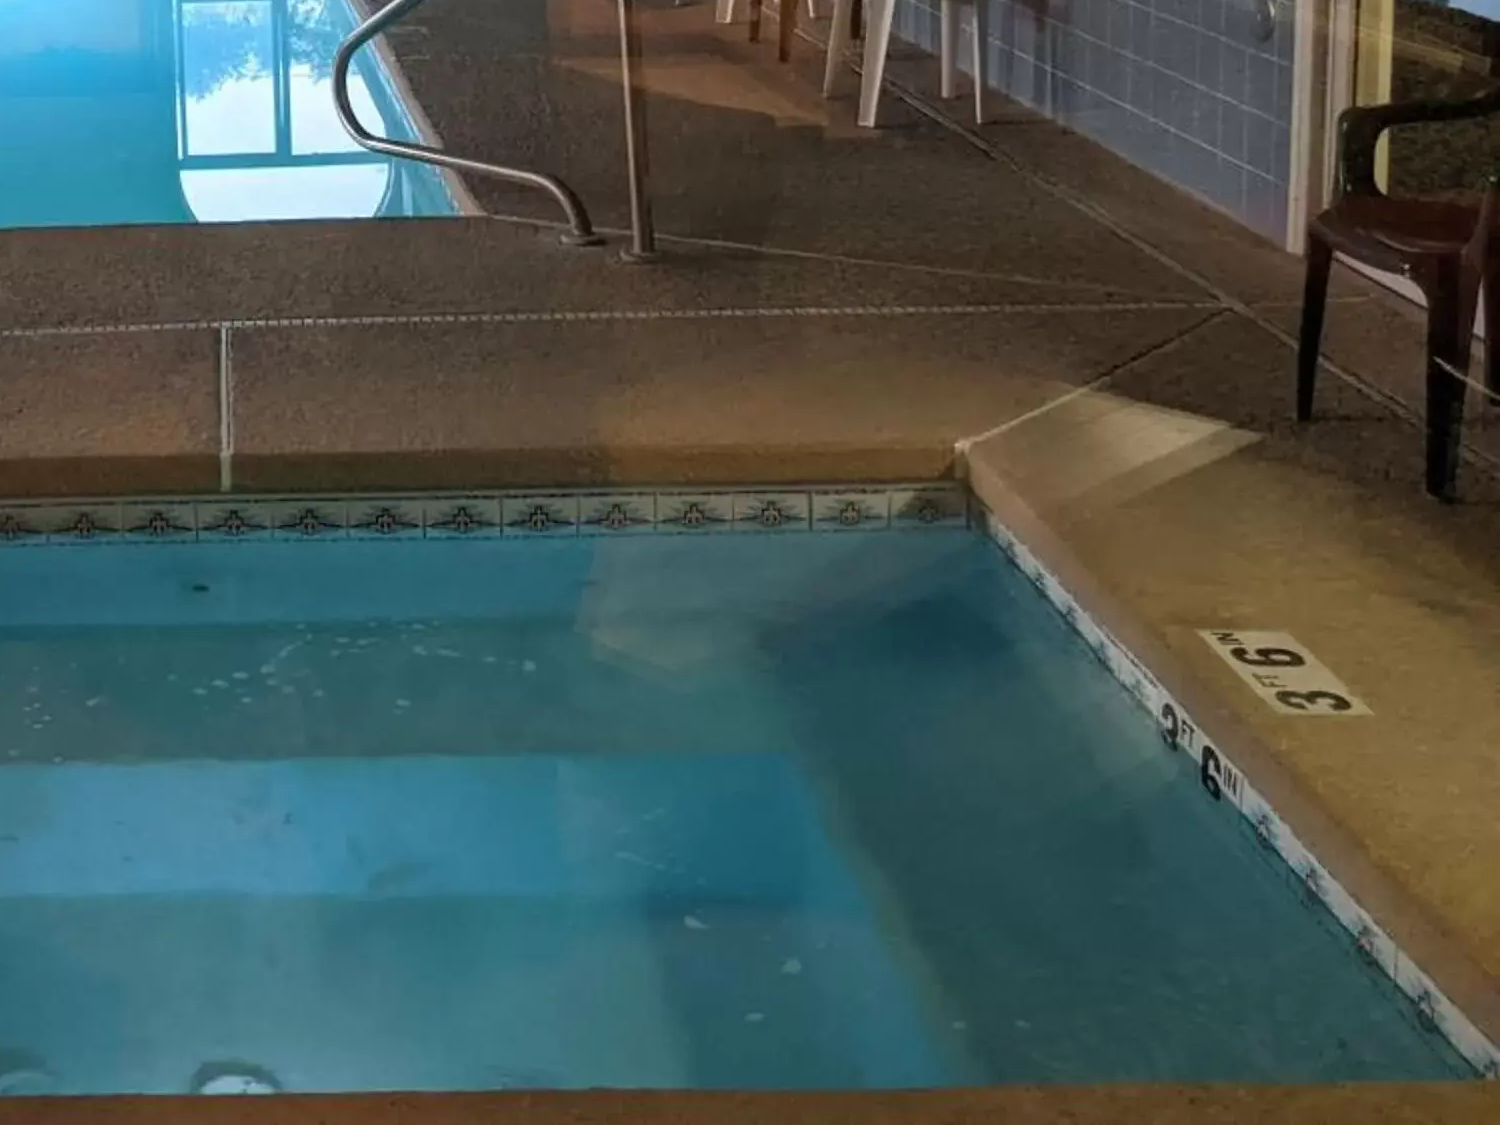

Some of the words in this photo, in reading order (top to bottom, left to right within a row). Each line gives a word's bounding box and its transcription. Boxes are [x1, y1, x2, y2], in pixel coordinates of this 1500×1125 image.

[1230, 647, 1306, 668] 6
[1274, 690, 1352, 712] 3
[1179, 719, 1196, 748] FT
[1201, 745, 1222, 801] 6
